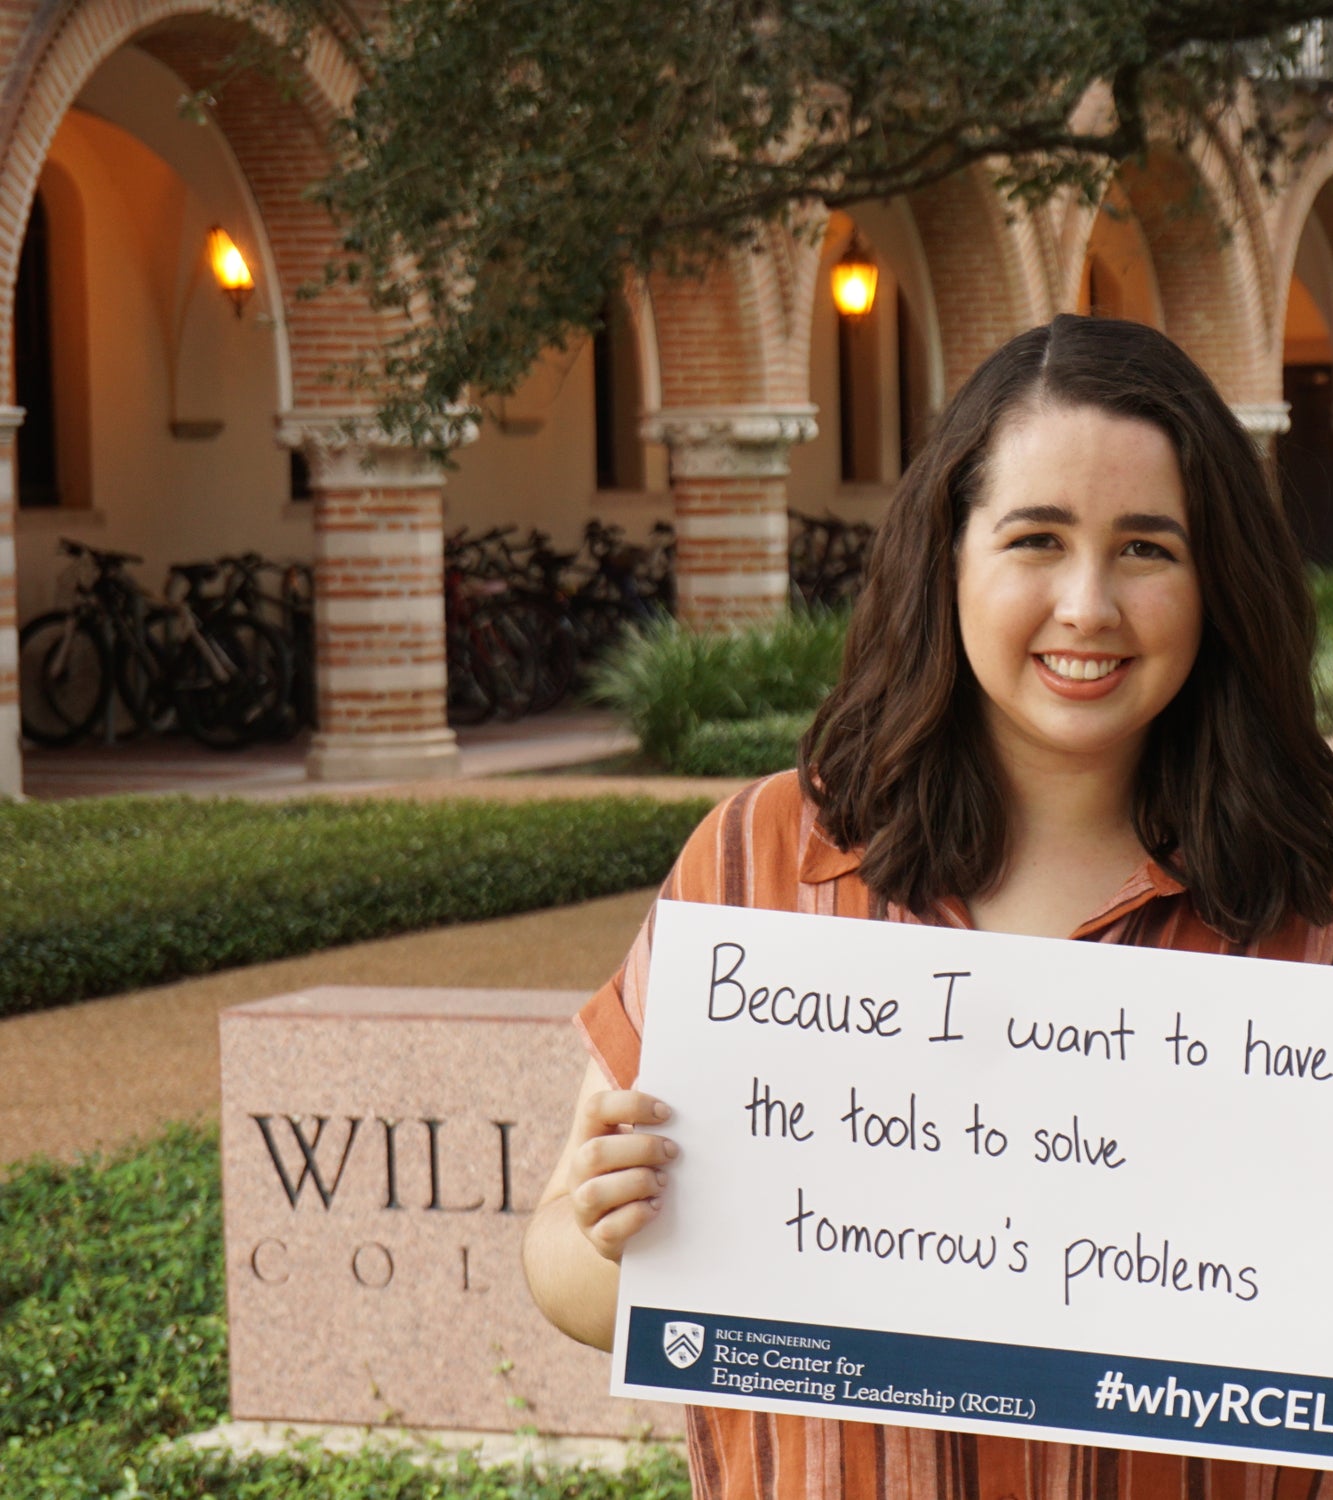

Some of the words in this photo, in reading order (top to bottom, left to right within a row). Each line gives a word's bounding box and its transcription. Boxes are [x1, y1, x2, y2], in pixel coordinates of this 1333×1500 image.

[708, 943, 903, 1037] Because
[930, 971, 971, 1043] I
[1007, 1008, 1135, 1061] want
[1166, 1012, 1208, 1066] to
[1245, 1020, 1333, 1080] have
[745, 1077, 814, 1140] the
[841, 1087, 941, 1153] tools
[965, 1104, 1008, 1157] to
[1034, 1116, 1126, 1169] solve
[786, 1189, 1029, 1273] tomorrow's
[1064, 1232, 1260, 1305] problems
[713, 1344, 759, 1366] Rice
[763, 1350, 832, 1374] Center
[836, 1357, 865, 1377] for
[715, 1329, 744, 1342] RICE
[746, 1332, 831, 1350] ENGINEERING
[712, 1367, 836, 1400] Engineering
[844, 1381, 955, 1412] Leadership
[959, 1393, 1036, 1420] (RCEL)
